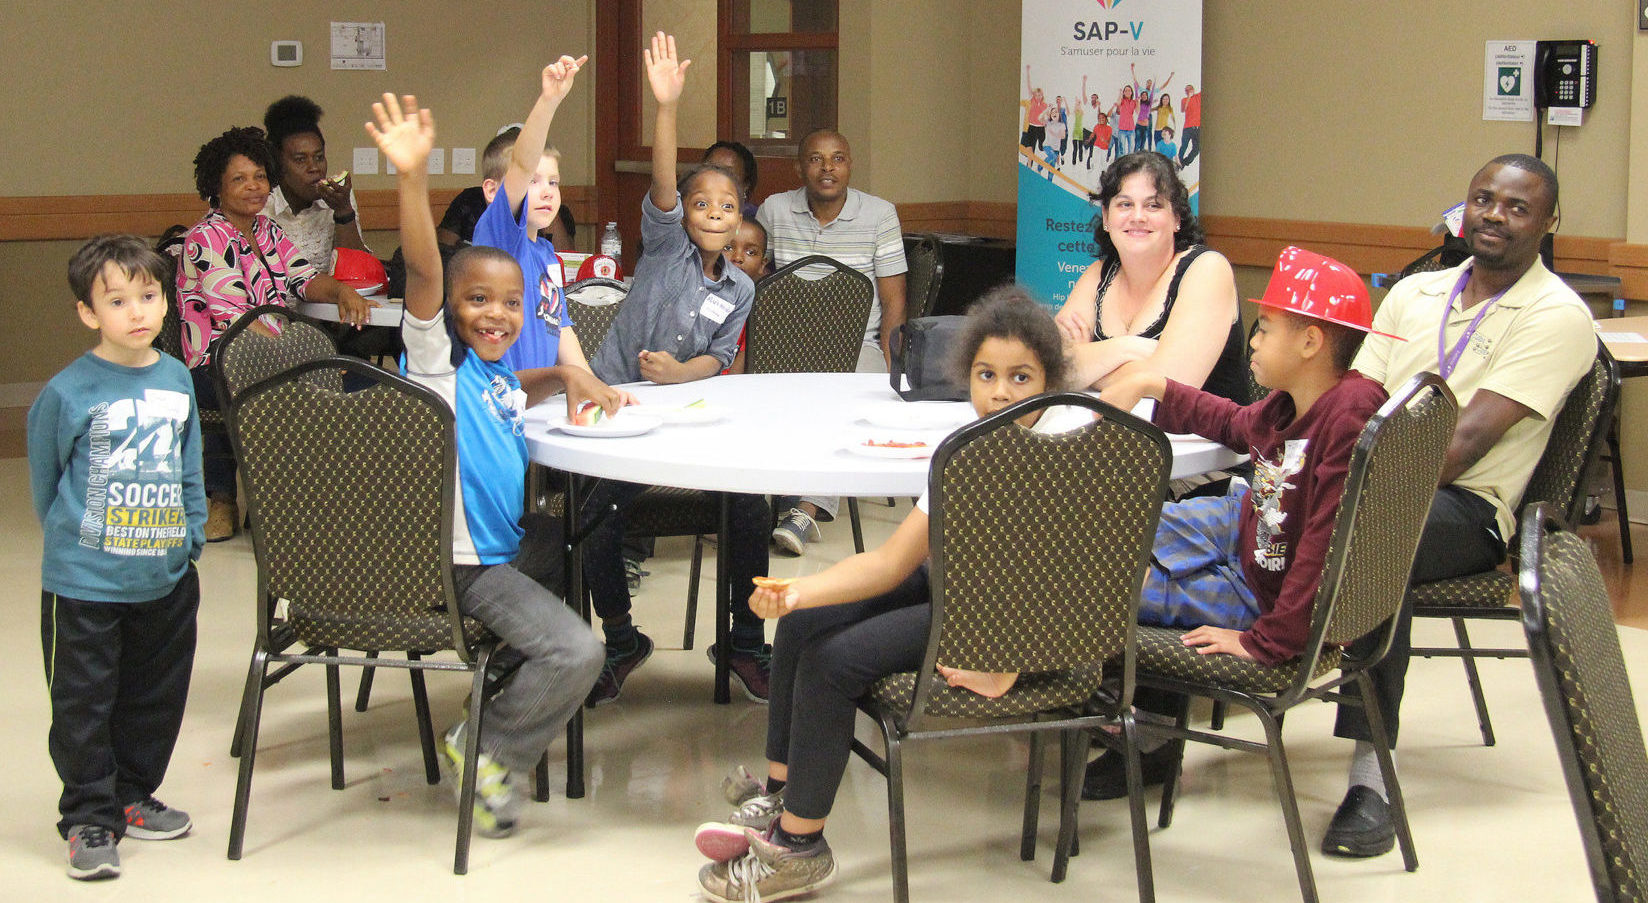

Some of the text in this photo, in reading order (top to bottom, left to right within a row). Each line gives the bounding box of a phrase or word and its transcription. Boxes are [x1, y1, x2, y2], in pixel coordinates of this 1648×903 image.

[1073, 21, 1144, 41] SAP-V
[1060, 46, 1156, 58] S'amuser pour la vie
[768, 100, 786, 115] 1B
[1046, 218, 1093, 232] Restez
[1057, 240, 1096, 253] cette
[1057, 261, 1088, 273] Vene
[1052, 293, 1066, 302] Hip
[108, 481, 183, 508] SOCCER
[110, 508, 185, 525] STRIKER
[104, 536, 184, 549] STATE PLAYFFS
